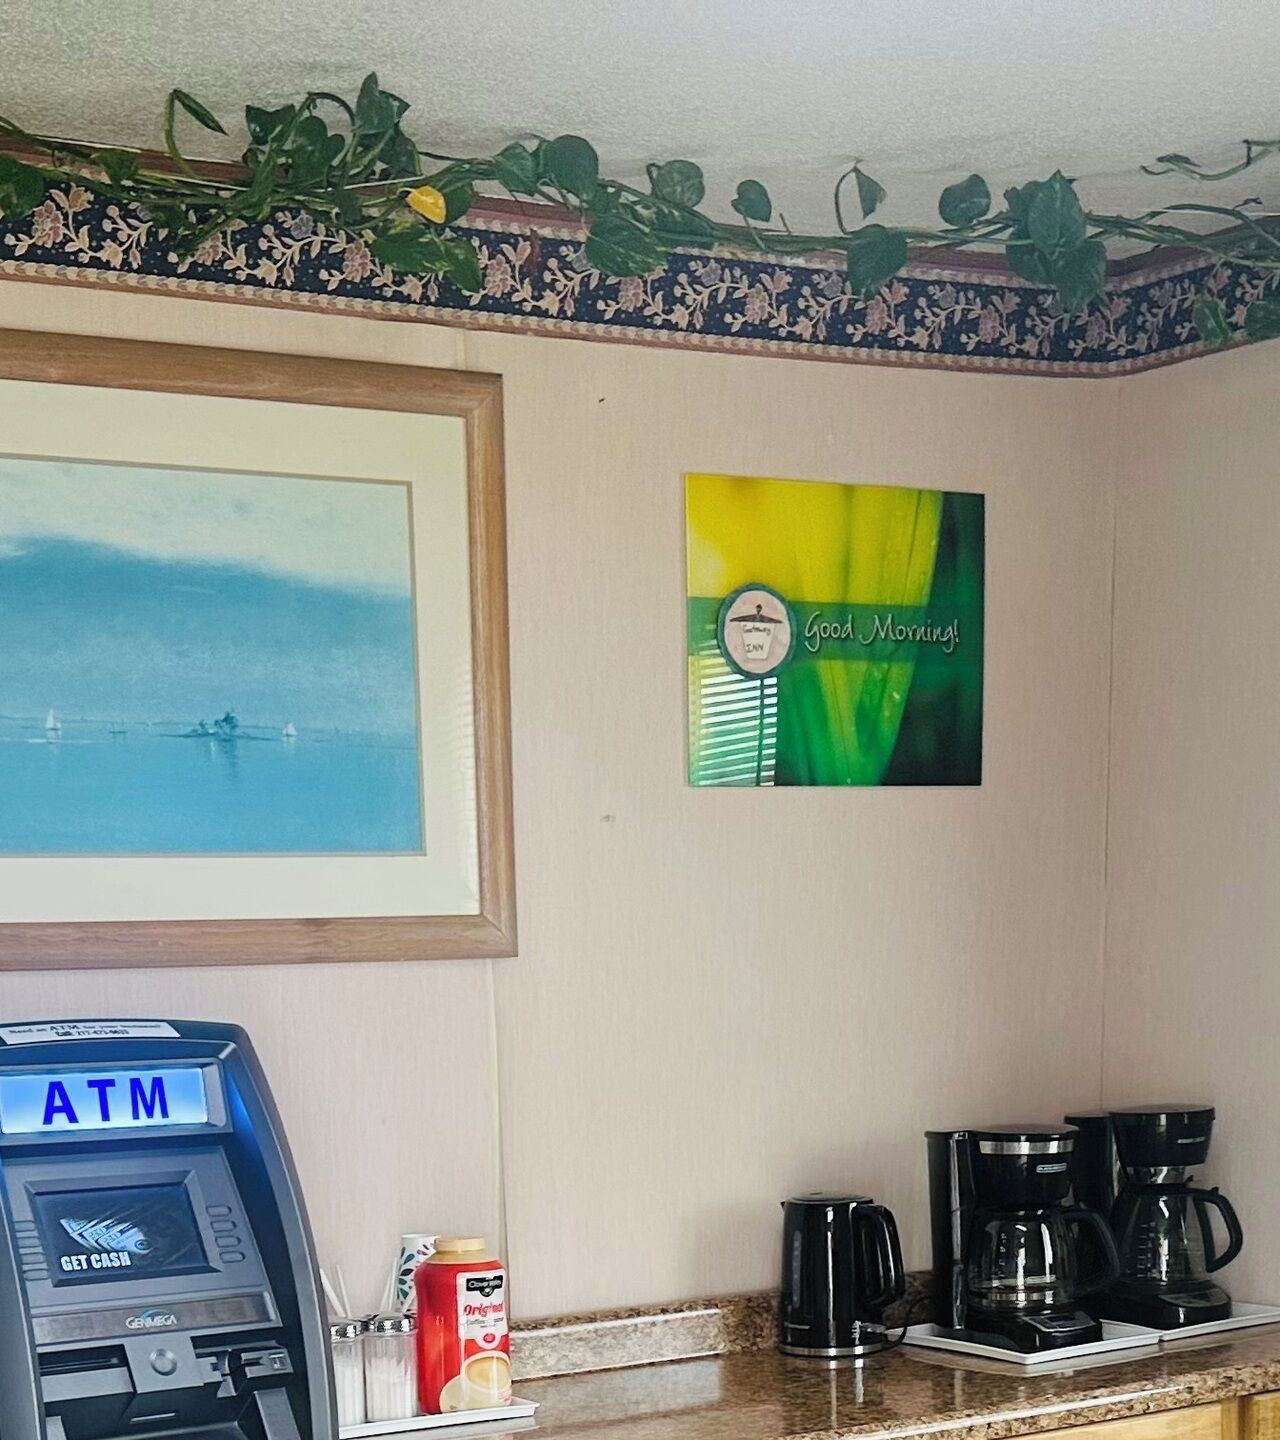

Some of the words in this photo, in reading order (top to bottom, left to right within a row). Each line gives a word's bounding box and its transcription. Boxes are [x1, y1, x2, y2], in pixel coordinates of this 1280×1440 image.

[745, 642, 764, 654] INN
[804, 611, 854, 652] Good
[858, 612, 959, 654] Morning!
[42, 1076, 170, 1125] ATM
[60, 1255, 89, 1272] GET
[90, 1251, 132, 1270] CASH
